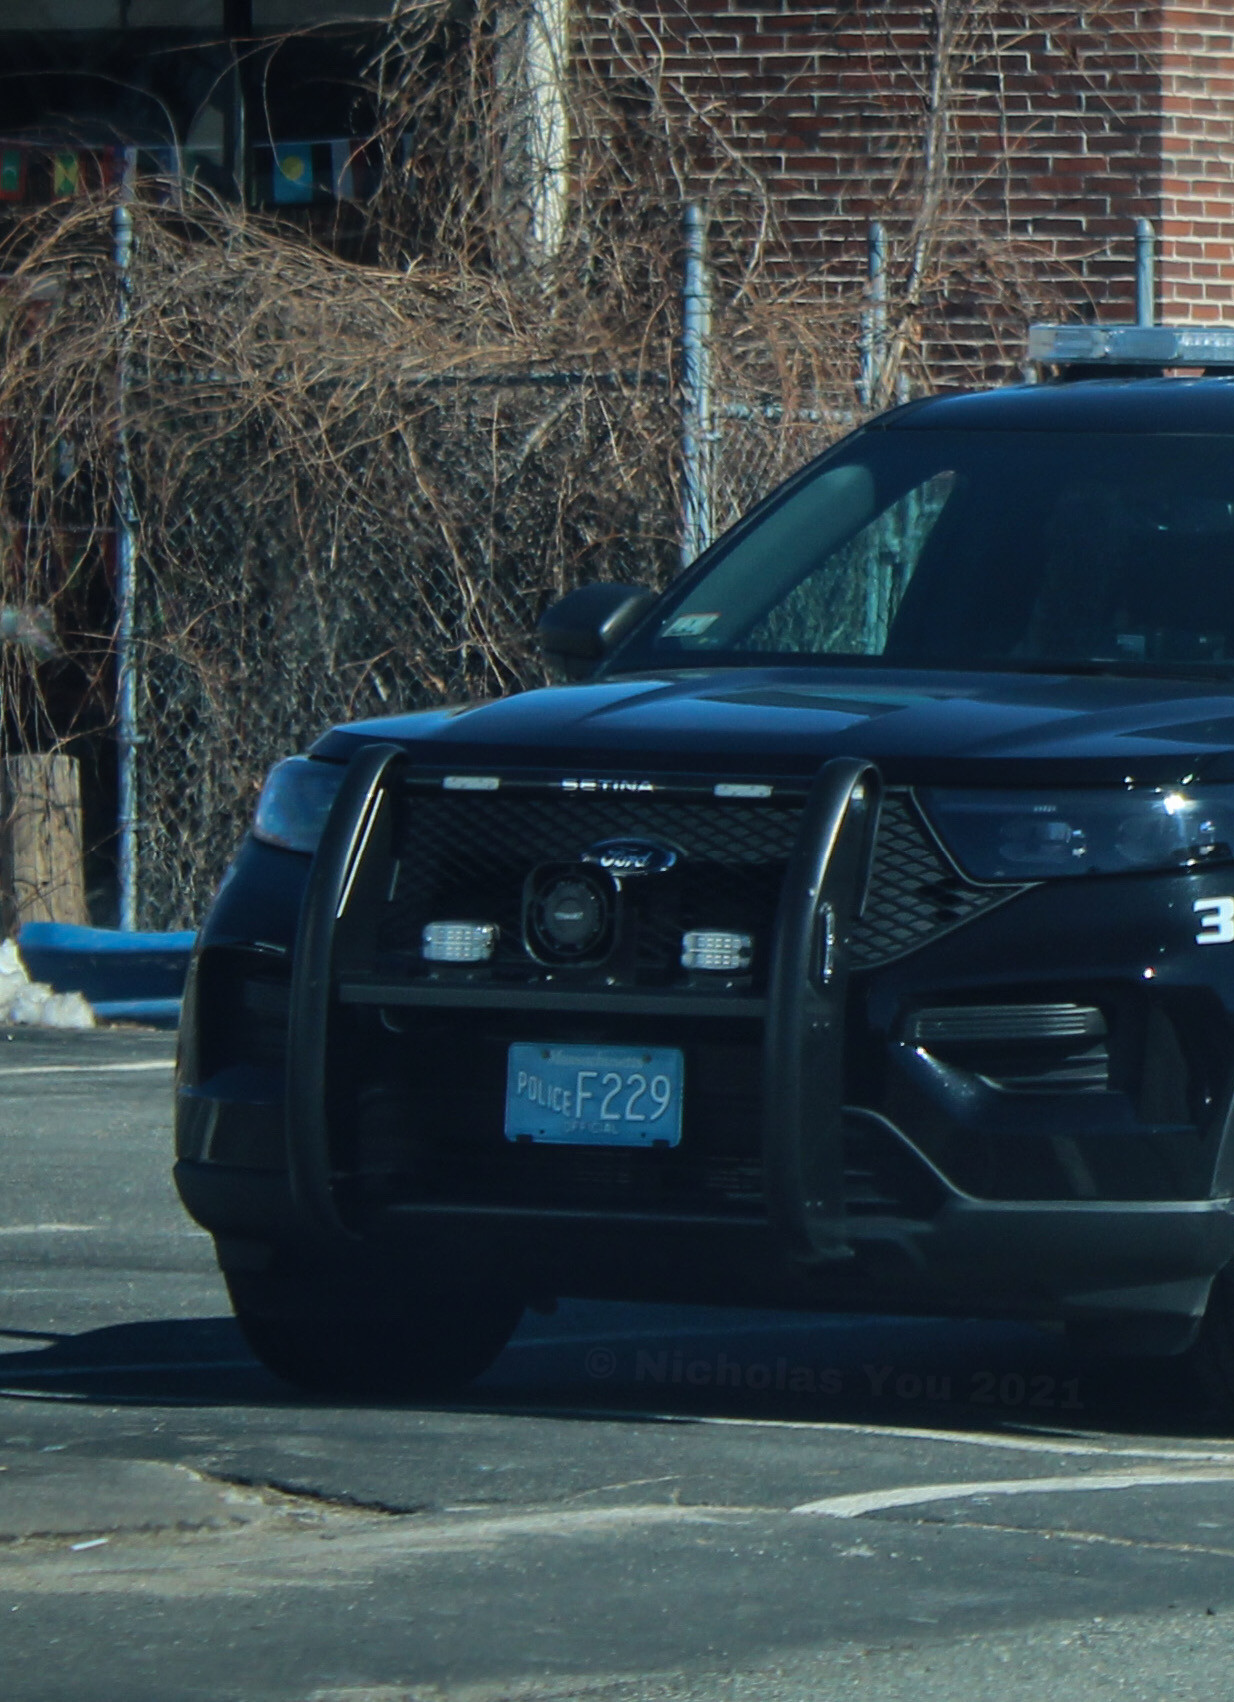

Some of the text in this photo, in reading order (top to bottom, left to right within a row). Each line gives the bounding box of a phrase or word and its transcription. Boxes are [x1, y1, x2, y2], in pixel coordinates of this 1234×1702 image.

[561, 778, 654, 793] SETINA
[517, 1071, 672, 1121] POLICE F229
